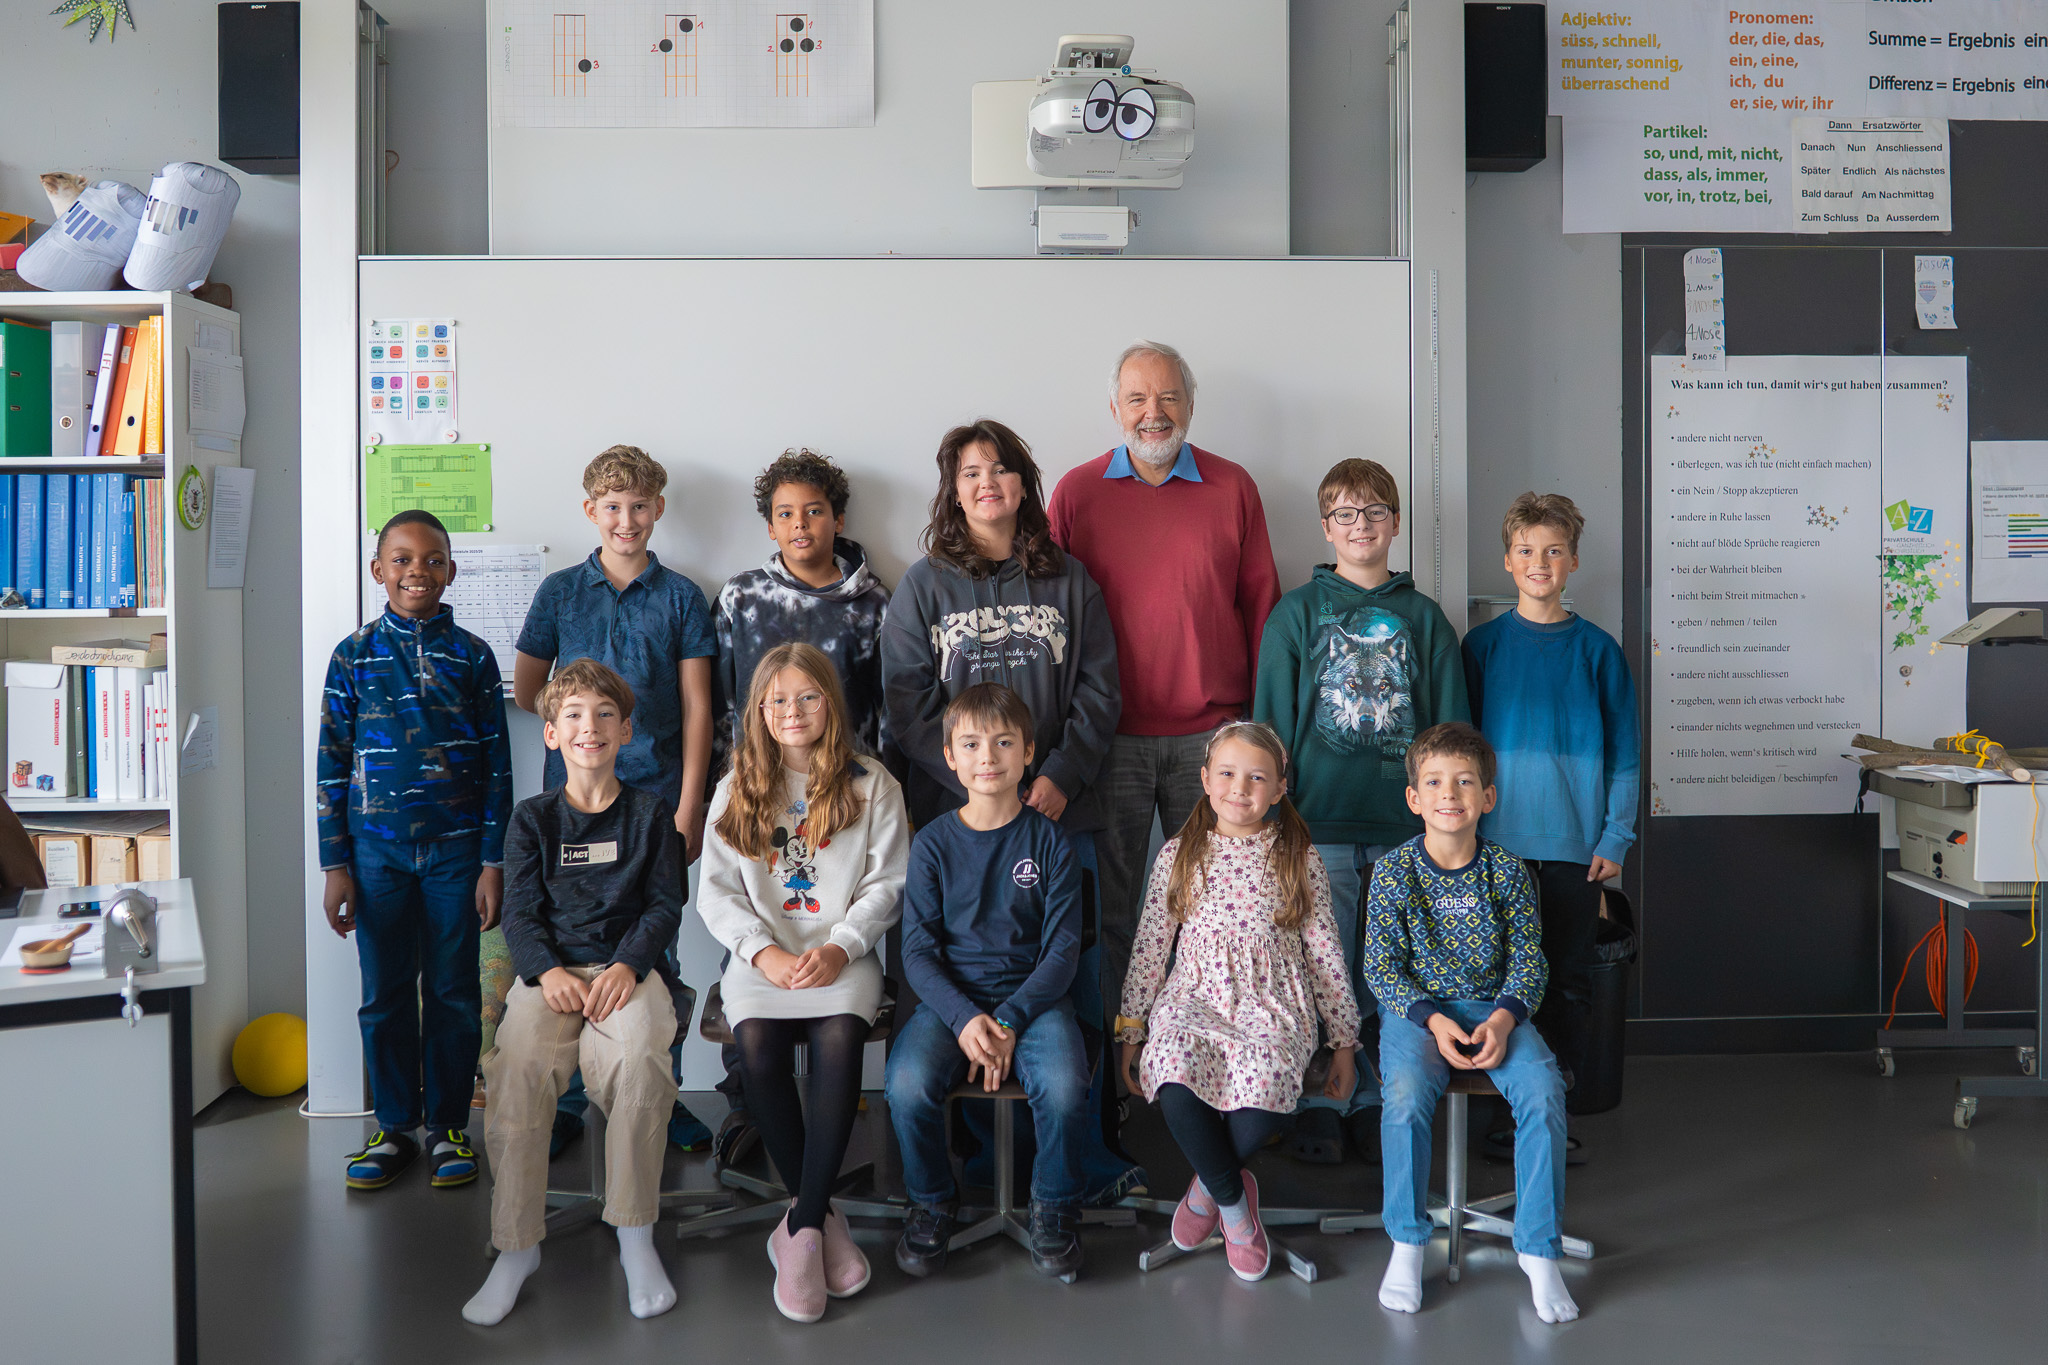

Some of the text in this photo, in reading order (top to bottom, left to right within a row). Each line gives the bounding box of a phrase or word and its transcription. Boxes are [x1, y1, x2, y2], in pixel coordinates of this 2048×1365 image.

[1561, 12, 1631, 29] Adjektiv:
[1730, 11, 1813, 24] Pronomen:
[1561, 33, 1661, 49] süss, schnell,
[1730, 32, 1824, 47] der, die, das,
[1869, 31, 1926, 47] Summe
[1948, 32, 2015, 51] Ergebnis
[1562, 55, 1683, 72] munter, sonnig,
[1730, 53, 1798, 68] ein, eine,
[1562, 76, 1669, 90] überraschend
[1730, 74, 1784, 89] ich, du
[1869, 75, 2048, 95] Differenz Ergebnis ein
[1729, 96, 1834, 112] er, sie, wir, ihr
[1644, 125, 1707, 138] Partikel:
[1828, 120, 1922, 130] Dann Ersatzwörter
[1643, 146, 1783, 162] so, und, mit, nicht,
[1800, 142, 1943, 153] Danach Nun Anschliessend
[1644, 167, 1768, 184] dass, als, immer,
[1800, 165, 1946, 177] Später Endlich Als nächstes
[1643, 189, 1772, 205] vor, in, trotz, bei,
[1801, 189, 1935, 200] Bald darauf Am Nachmittag
[1801, 212, 1940, 223] Zum Schluss Da Ausserdem
[1670, 379, 1694, 390] Was
[1696, 379, 1724, 390] kann
[1727, 379, 1743, 390] ich
[1746, 380, 1768, 391] tun,
[1770, 379, 1801, 390] damit
[1830, 380, 1848, 393] gut
[1849, 379, 1882, 390] haben
[1886, 380, 1948, 390] zusammen?
[1676, 432, 1764, 443] andere nicht nerven
[1744, 459, 1758, 469] ich
[1760, 460, 1774, 469] tue
[1775, 459, 1800, 470] (nicht
[1802, 459, 1833, 469] einfach
[1834, 459, 1872, 469] machen)
[1676, 485, 1799, 498] ein Nein Stopp akzeptieren
[1676, 511, 1771, 522] andere in Ruhe lassen
[1676, 537, 1821, 550] nicht auf blöde Sprüche reagieren
[1676, 564, 1783, 575] bei der Wahrheit bleiben
[1677, 590, 1799, 601] nicht beim Streit mitmachen
[1676, 616, 1778, 629] geben nehmen teilen
[1677, 643, 1791, 653] freundlich sein zueinander
[1676, 669, 1789, 680] andere nicht ausschliessen
[1676, 696, 1715, 708] zugeben,
[1743, 695, 1757, 705] ich
[1758, 697, 1784, 705] etwas
[1785, 694, 1823, 705] verbockt
[1824, 694, 1846, 704] habe
[1676, 720, 1861, 733] einander nichts wegnehmen und verstecken
[1676, 748, 1699, 758] Hilfe
[1700, 748, 1728, 758] holen,
[1762, 746, 1795, 757] kritisch
[1797, 747, 1817, 756] wird
[1676, 772, 1838, 785] andere nicht beleidigen beschimpfen
[1435, 898, 1476, 909] GUESS
